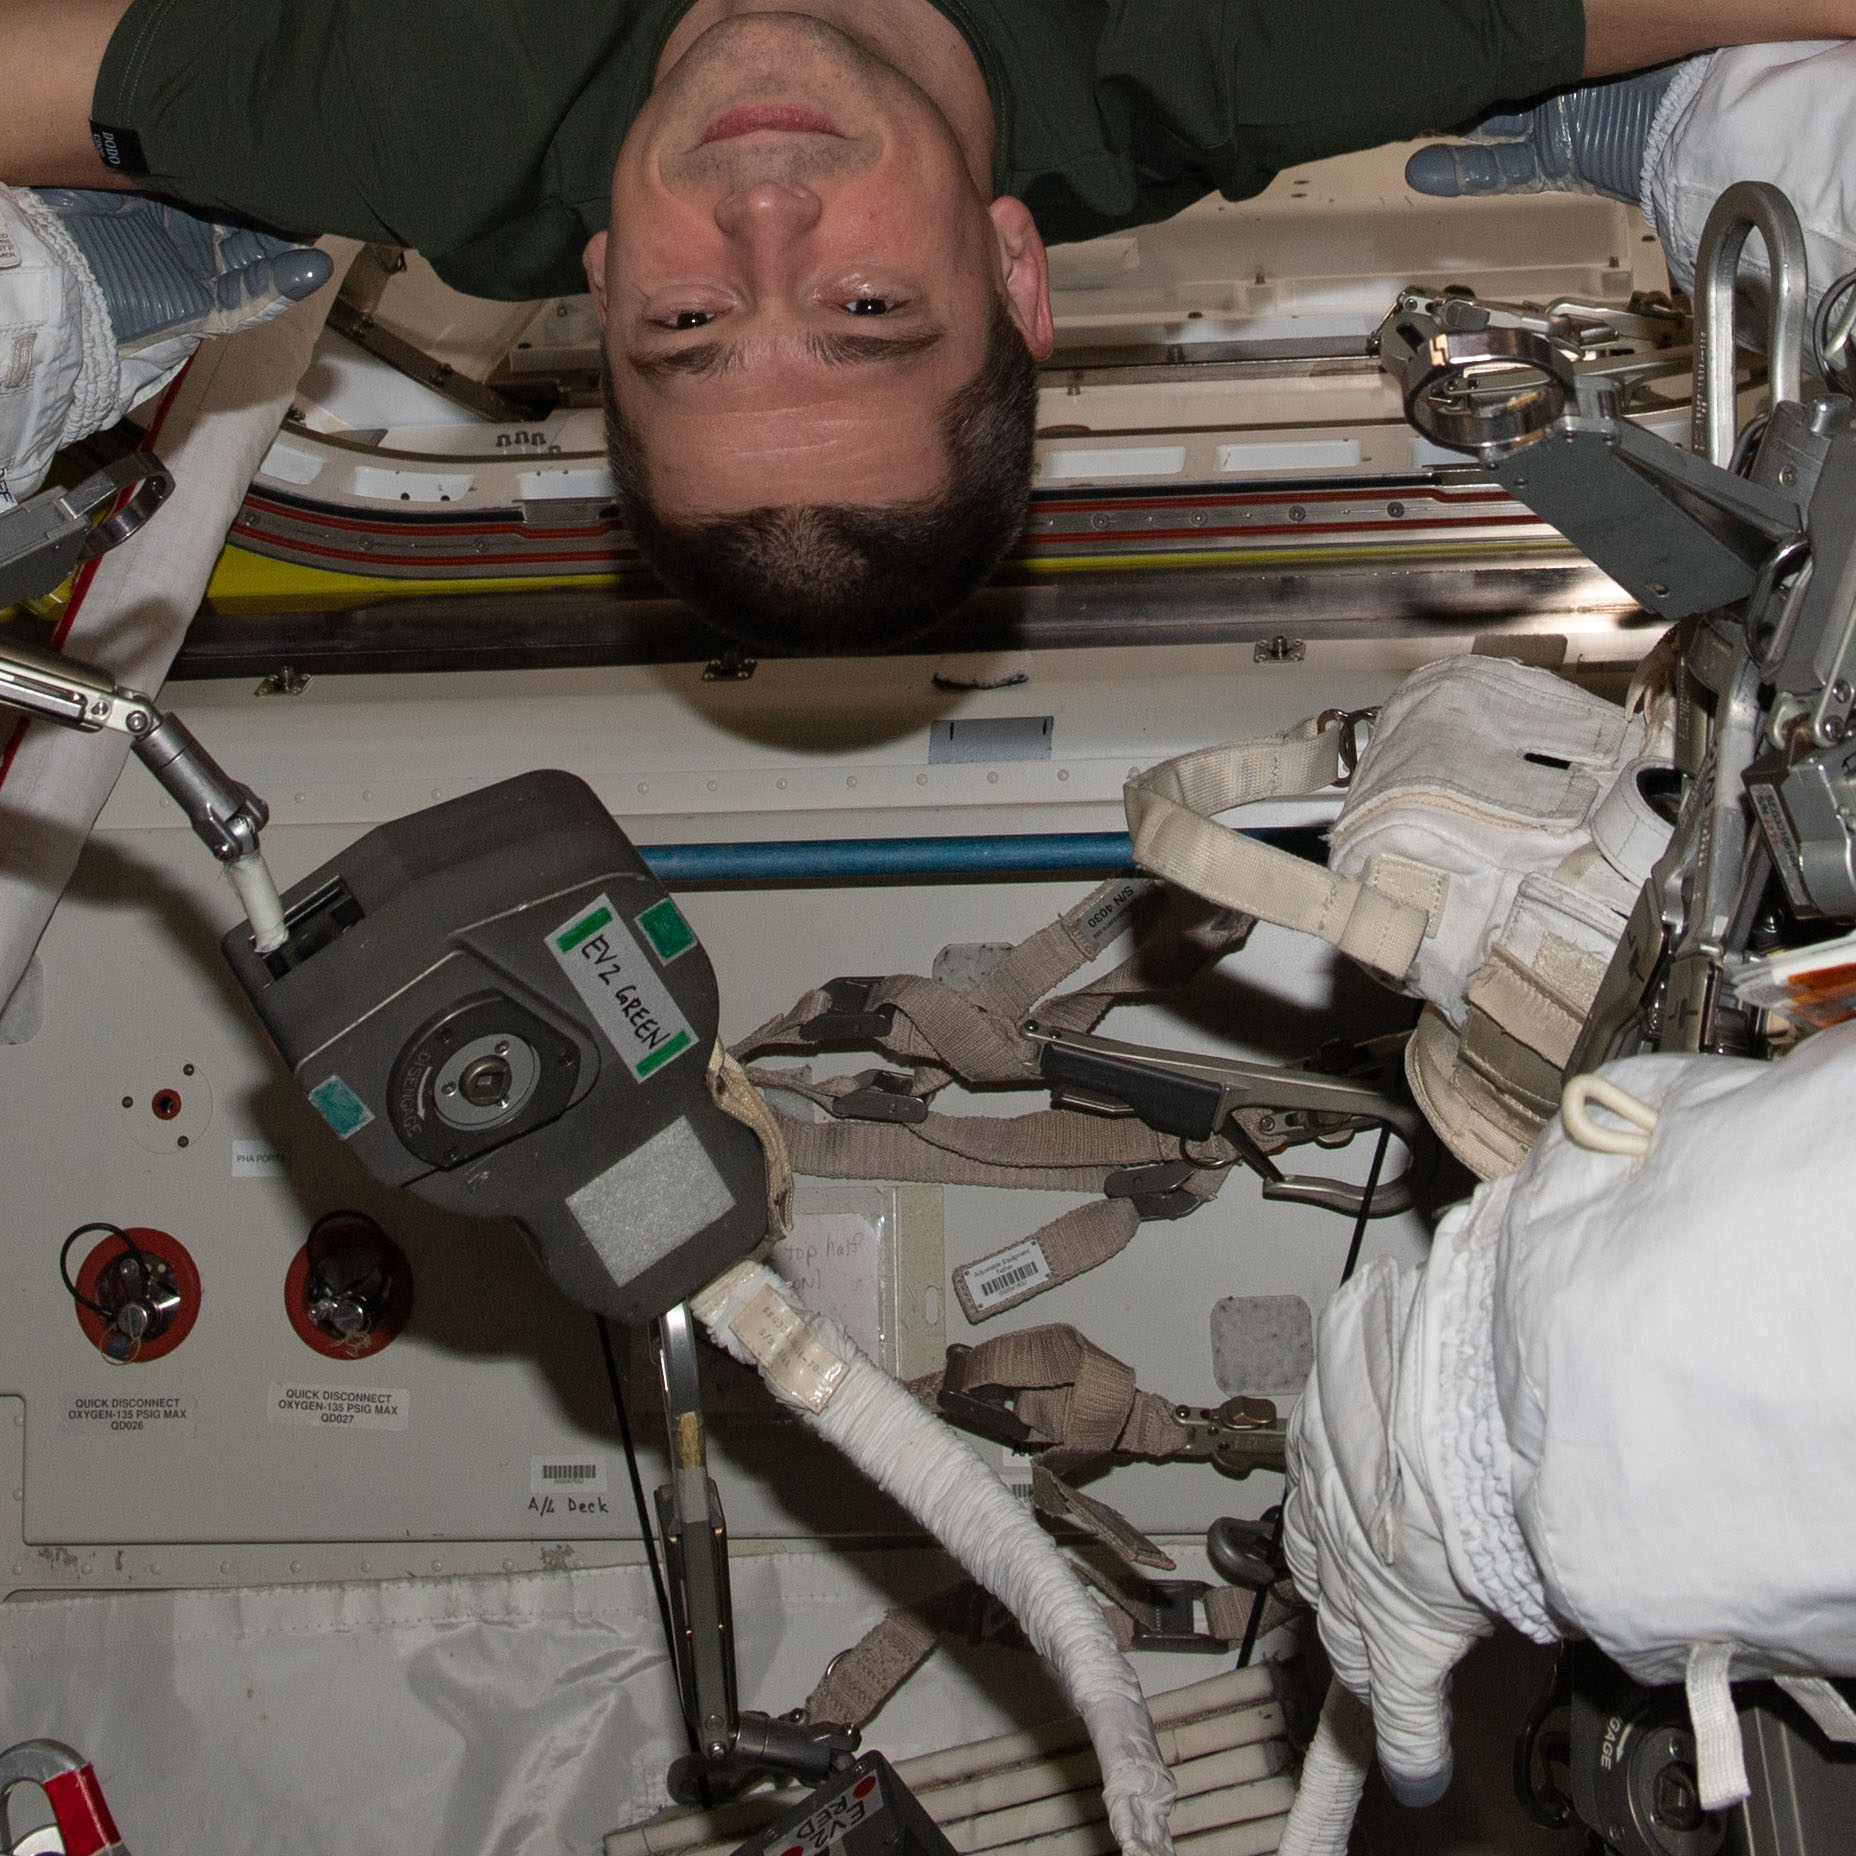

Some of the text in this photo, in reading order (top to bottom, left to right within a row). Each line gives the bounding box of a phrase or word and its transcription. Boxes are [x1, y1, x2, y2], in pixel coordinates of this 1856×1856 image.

[1113, 886, 1134, 906] S/N
[1087, 904, 1114, 928] 4030
[615, 985, 670, 1050] GREEN
[400, 1052, 433, 1138] DISENGAGE
[237, 1154, 254, 1164] PHA
[784, 1233, 865, 1266] top half
[75, 1398, 179, 1408] QUICK DISCONNECT
[286, 1389, 392, 1404] QUICK DISCONNECT
[68, 1409, 186, 1420] OXYGEN-135 PSIG MAX
[278, 1399, 398, 1415] OXYGEN-135 PSIG MAX
[111, 1421, 144, 1431] QD026
[321, 1414, 354, 1425] QD027
[568, 1497, 609, 1513] Deck
[1601, 1716, 1621, 1771] GAGE
[796, 1795, 848, 1839] RED
[809, 1800, 866, 1849] EV2
